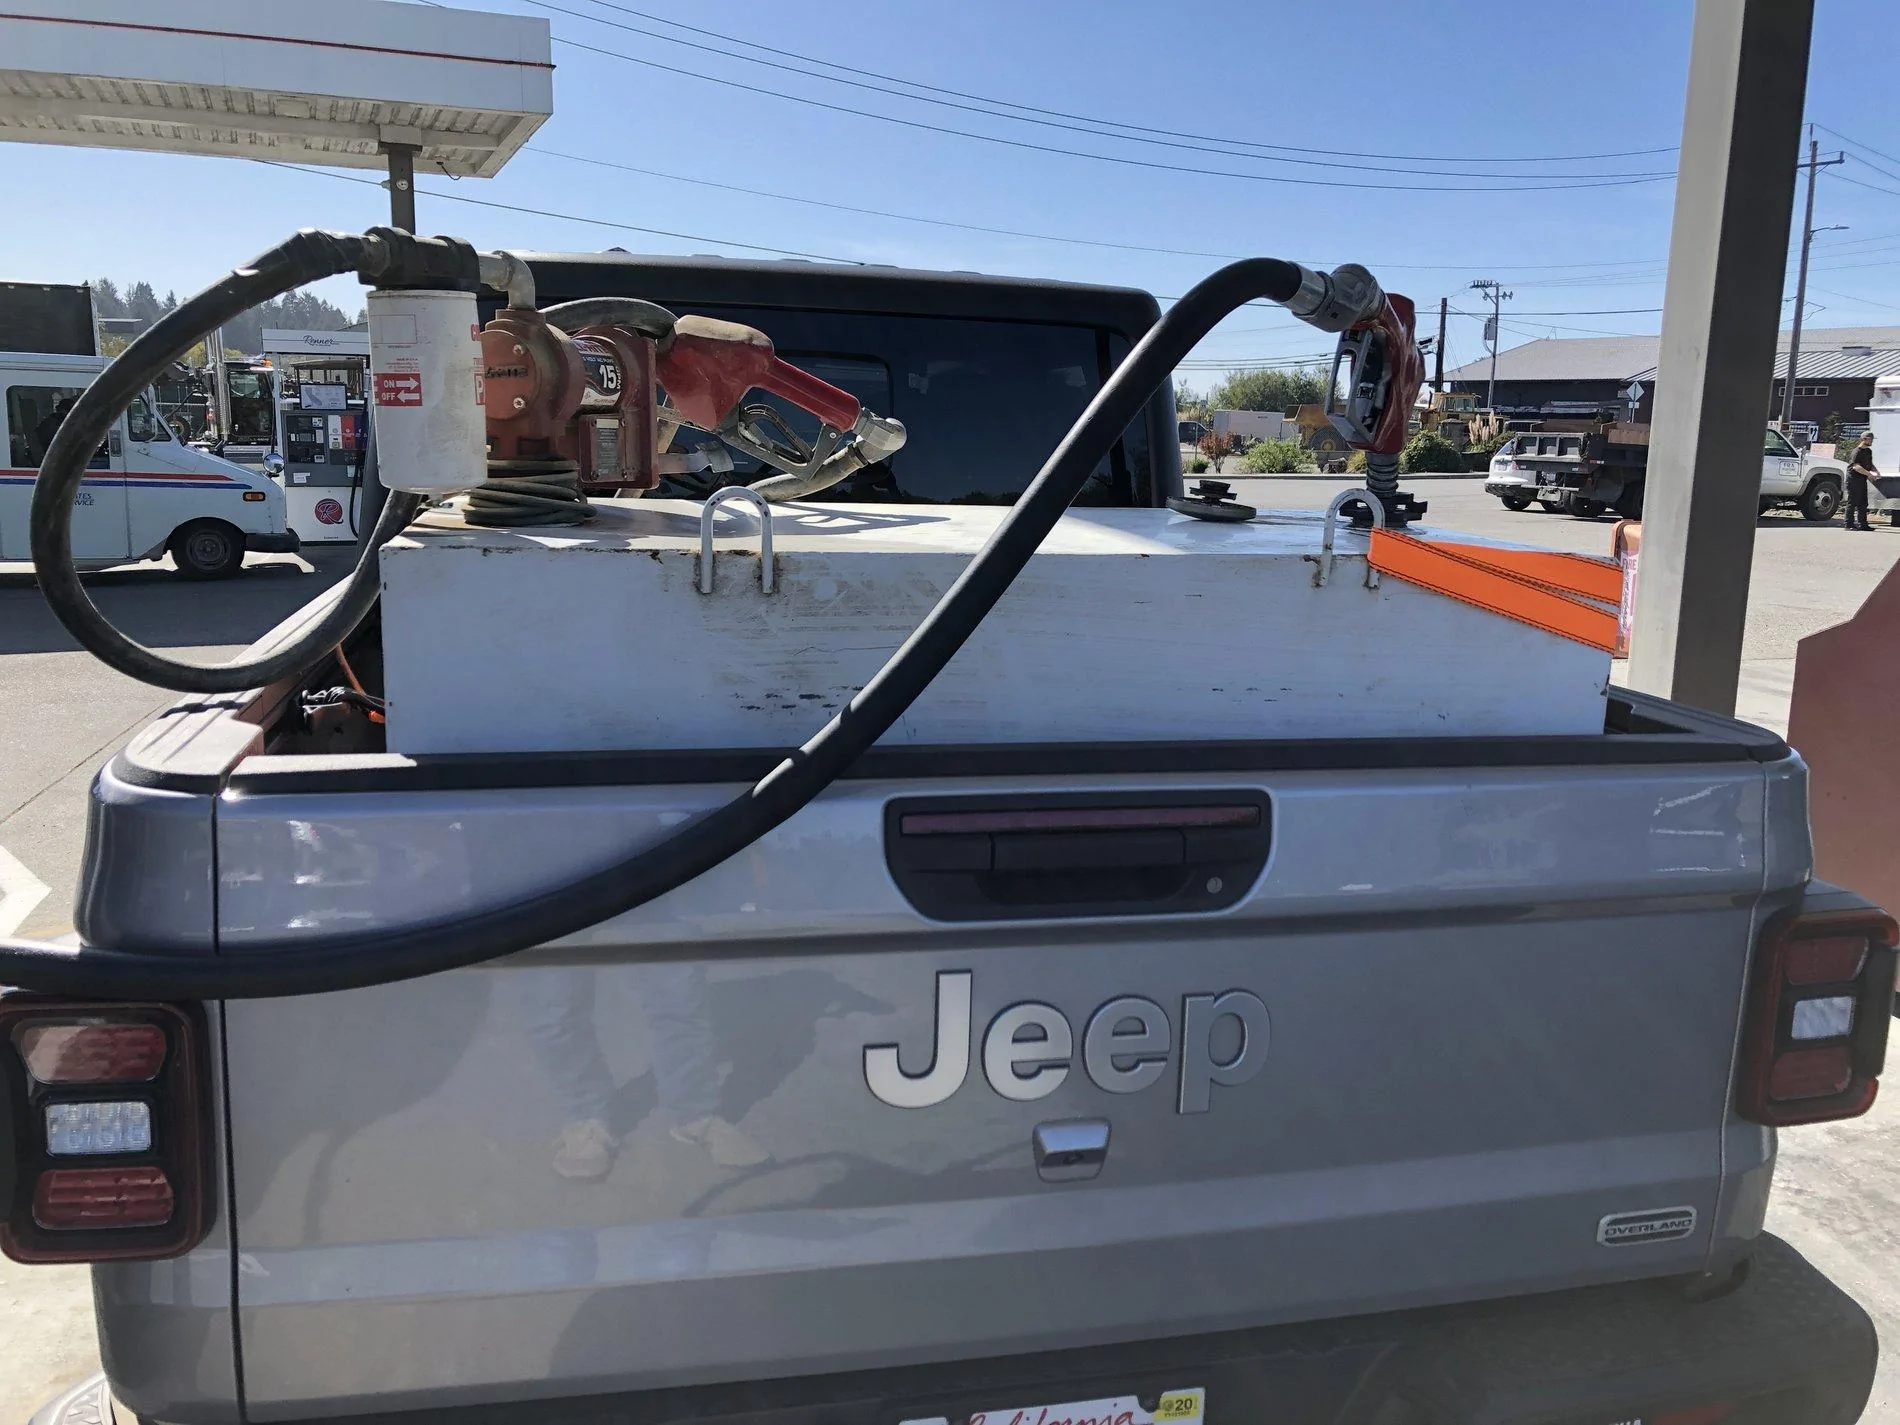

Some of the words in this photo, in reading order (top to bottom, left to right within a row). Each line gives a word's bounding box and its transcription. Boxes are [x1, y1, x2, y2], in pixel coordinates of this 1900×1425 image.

[383, 379, 395, 388] ON
[599, 364, 617, 389] 15
[381, 392, 396, 401] OFF
[863, 968, 1272, 1115] Jeep
[1604, 1219, 1693, 1236] OVERLAND
[1174, 1398, 1193, 1412] 20
[968, 1407, 1135, 1425] lfrnia
